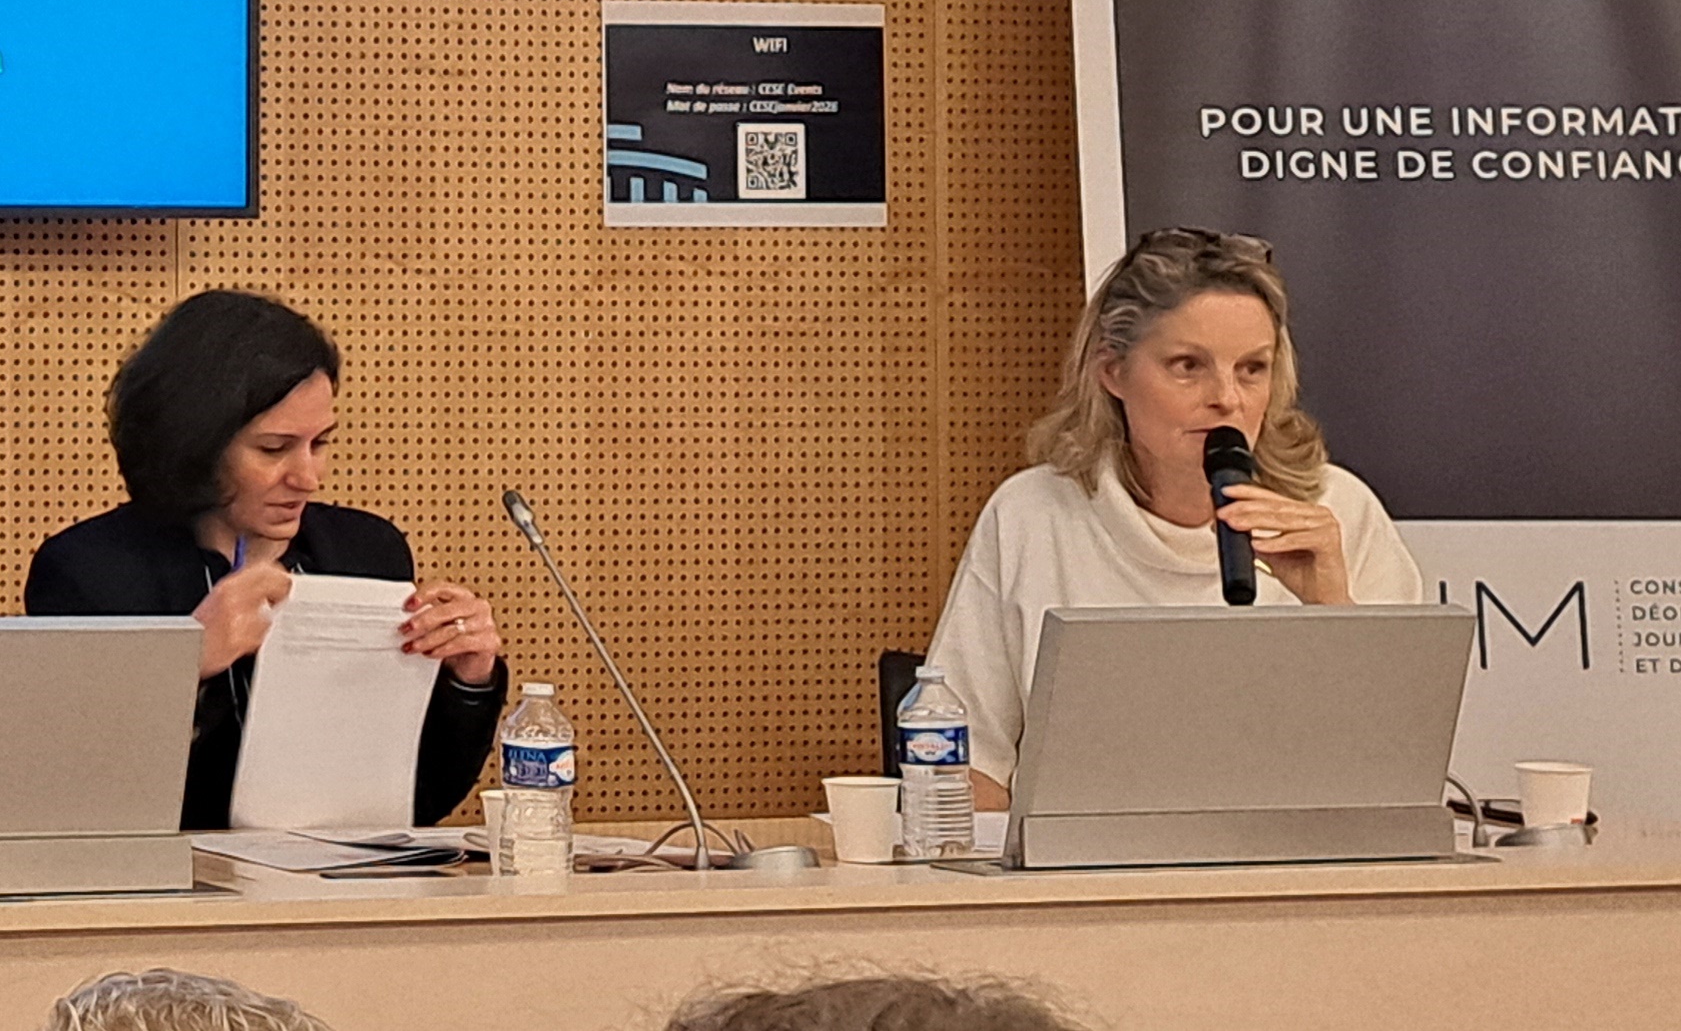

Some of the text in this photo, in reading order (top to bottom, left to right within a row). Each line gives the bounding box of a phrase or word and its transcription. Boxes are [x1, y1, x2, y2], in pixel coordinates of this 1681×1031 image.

[753, 37, 787, 53] WIFI
[1199, 106, 1324, 138] POUR
[1343, 106, 1432, 137] UNE
[1240, 150, 1378, 181] DIGNE
[1397, 150, 1455, 181] DE
[1634, 632, 1681, 646] JOU
[1636, 658, 1660, 673] ET
